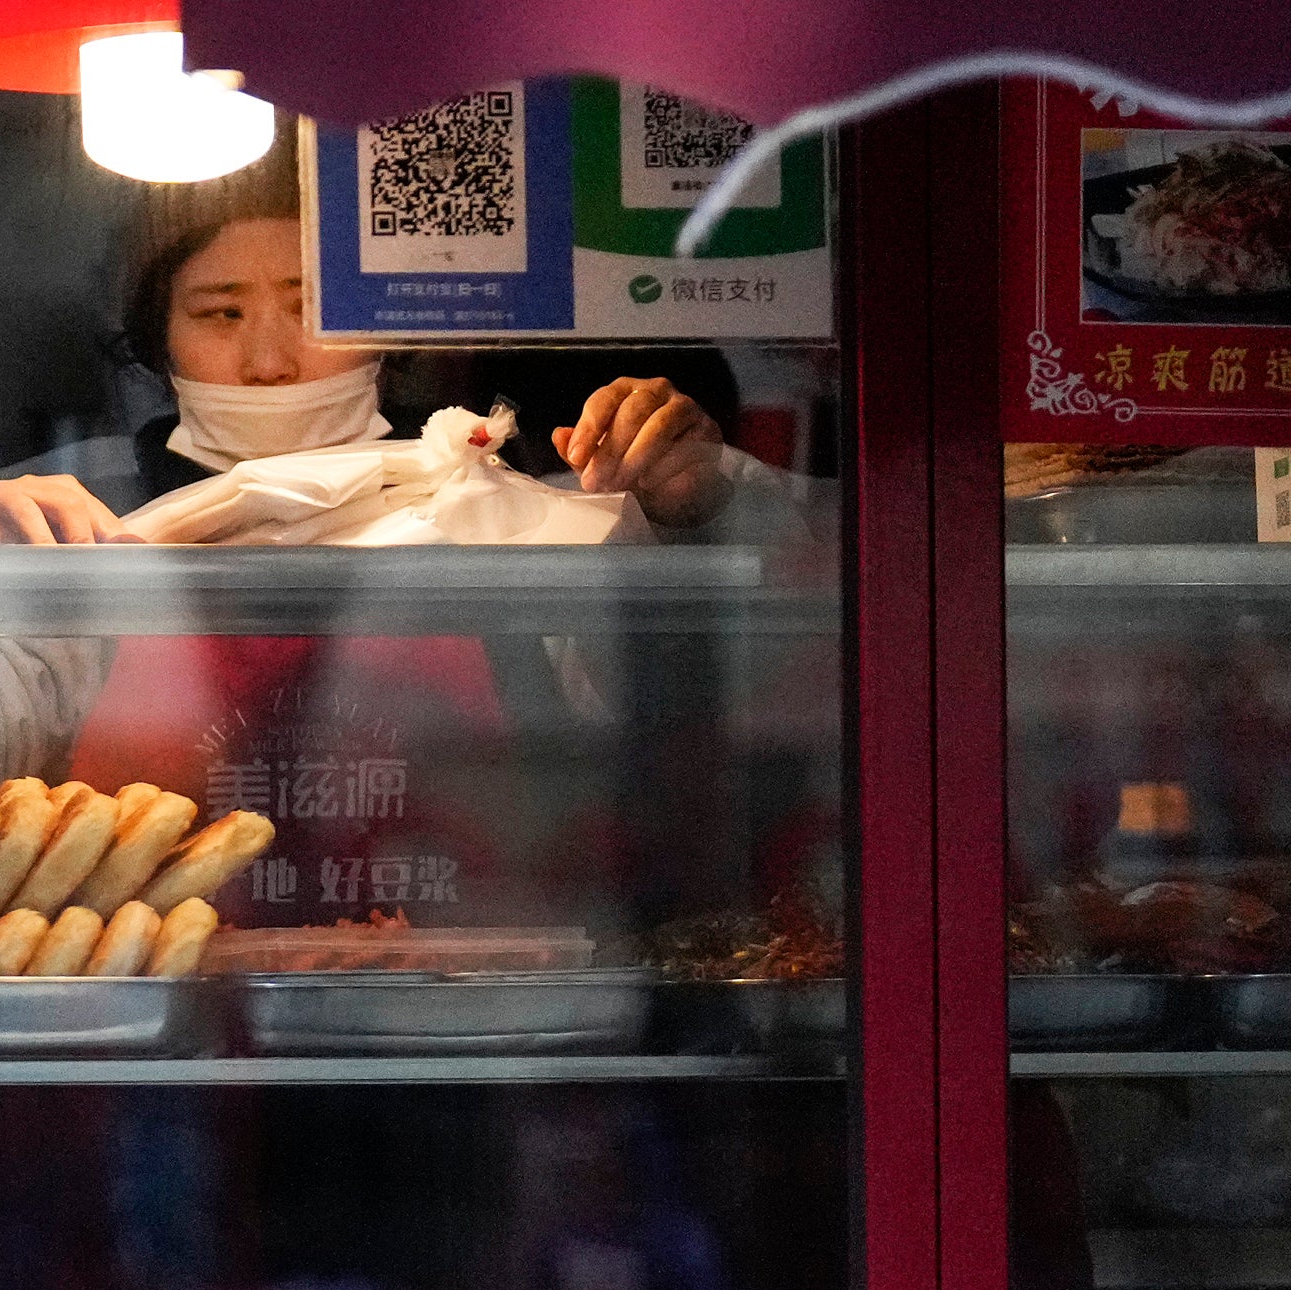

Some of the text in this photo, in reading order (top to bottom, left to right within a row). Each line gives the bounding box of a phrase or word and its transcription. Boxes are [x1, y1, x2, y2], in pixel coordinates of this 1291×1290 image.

[672, 277, 776, 302] 微信支付
[206, 755, 408, 820] 美滋源
